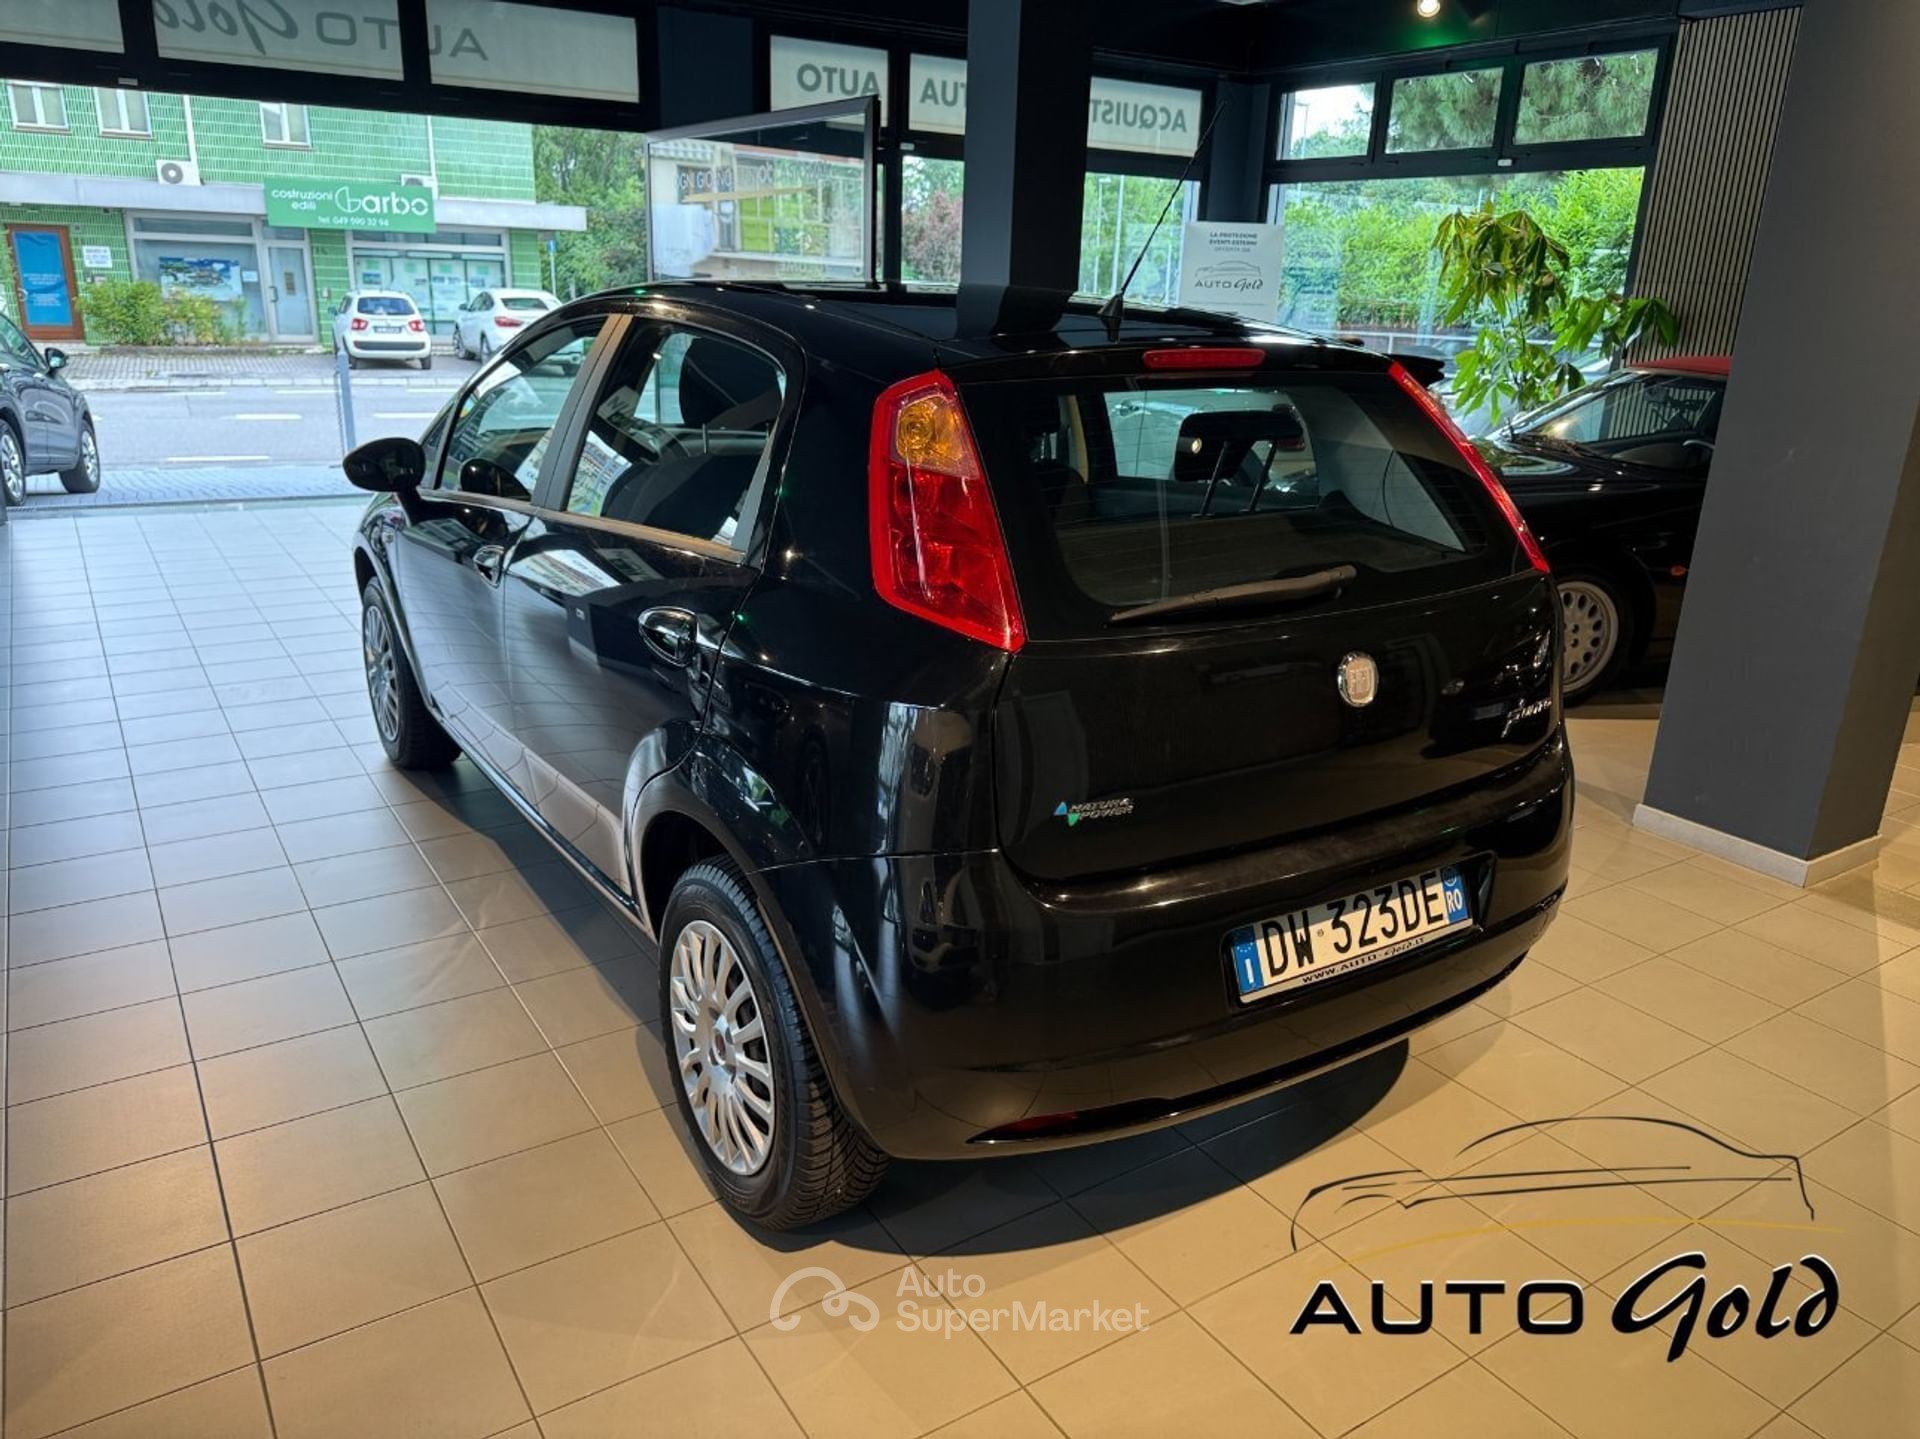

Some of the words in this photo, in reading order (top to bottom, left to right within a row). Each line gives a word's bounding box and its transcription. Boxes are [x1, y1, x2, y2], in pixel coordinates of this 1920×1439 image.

[271, 187, 334, 201] costruzioni
[1194, 279, 1232, 289] AUTO
[1262, 910, 1315, 978] DW
[1326, 873, 1444, 954] 323DE
[1445, 888, 1463, 914] RO
